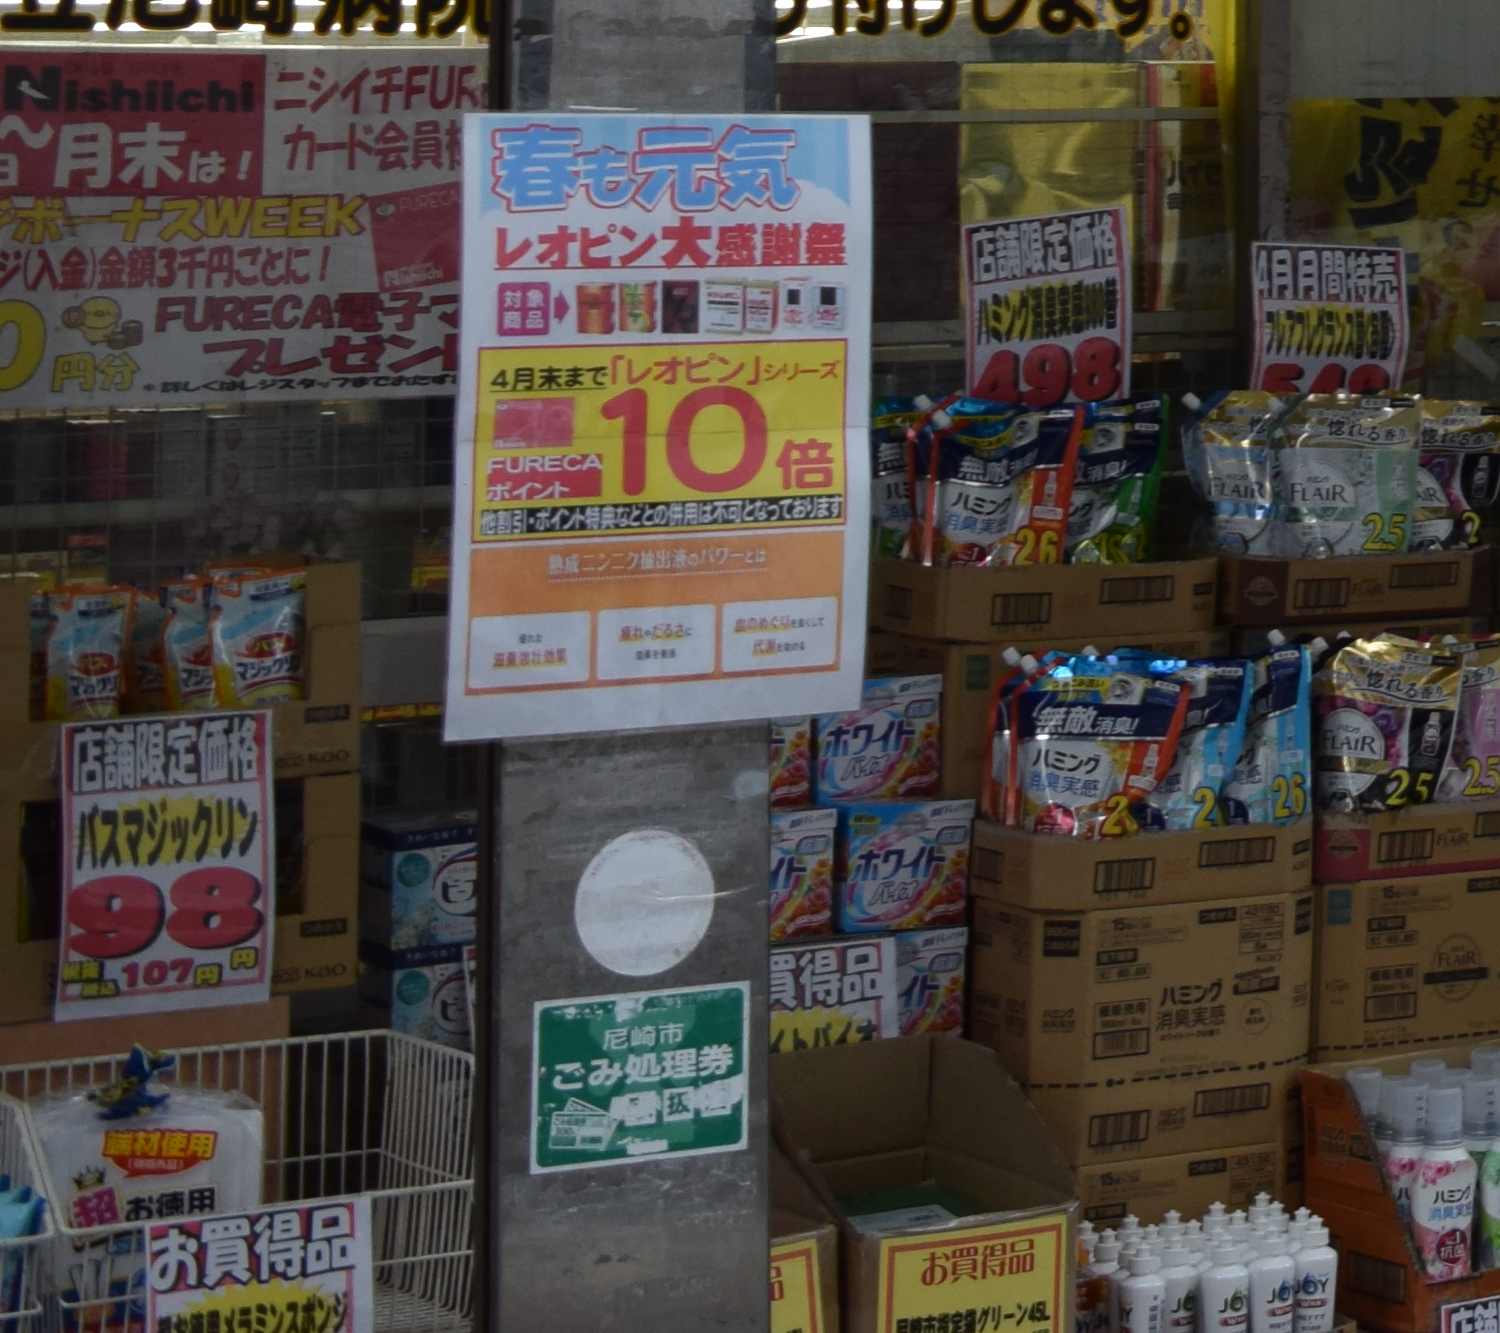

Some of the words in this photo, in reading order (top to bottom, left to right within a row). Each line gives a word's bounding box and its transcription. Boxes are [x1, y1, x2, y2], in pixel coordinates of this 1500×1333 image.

[4, 65, 254, 114] Nishiichi
[489, 124, 800, 213] 春も元気
[494, 222, 847, 269] レオピン大感謝祭
[970, 213, 1118, 284] 店舗限定価格
[490, 364, 609, 391] 4月末まで
[486, 454, 604, 474] FURECA
[485, 479, 570, 501] ポイント
[72, 717, 259, 792] 店舗限定価格
[1031, 747, 1100, 776] ハミング
[76, 798, 259, 870] バスマジックリン
[852, 845, 946, 883] ホワイト
[66, 867, 265, 959] 98
[150, 1203, 356, 1292] お買得品
[921, 1237, 1036, 1287] お買得品
